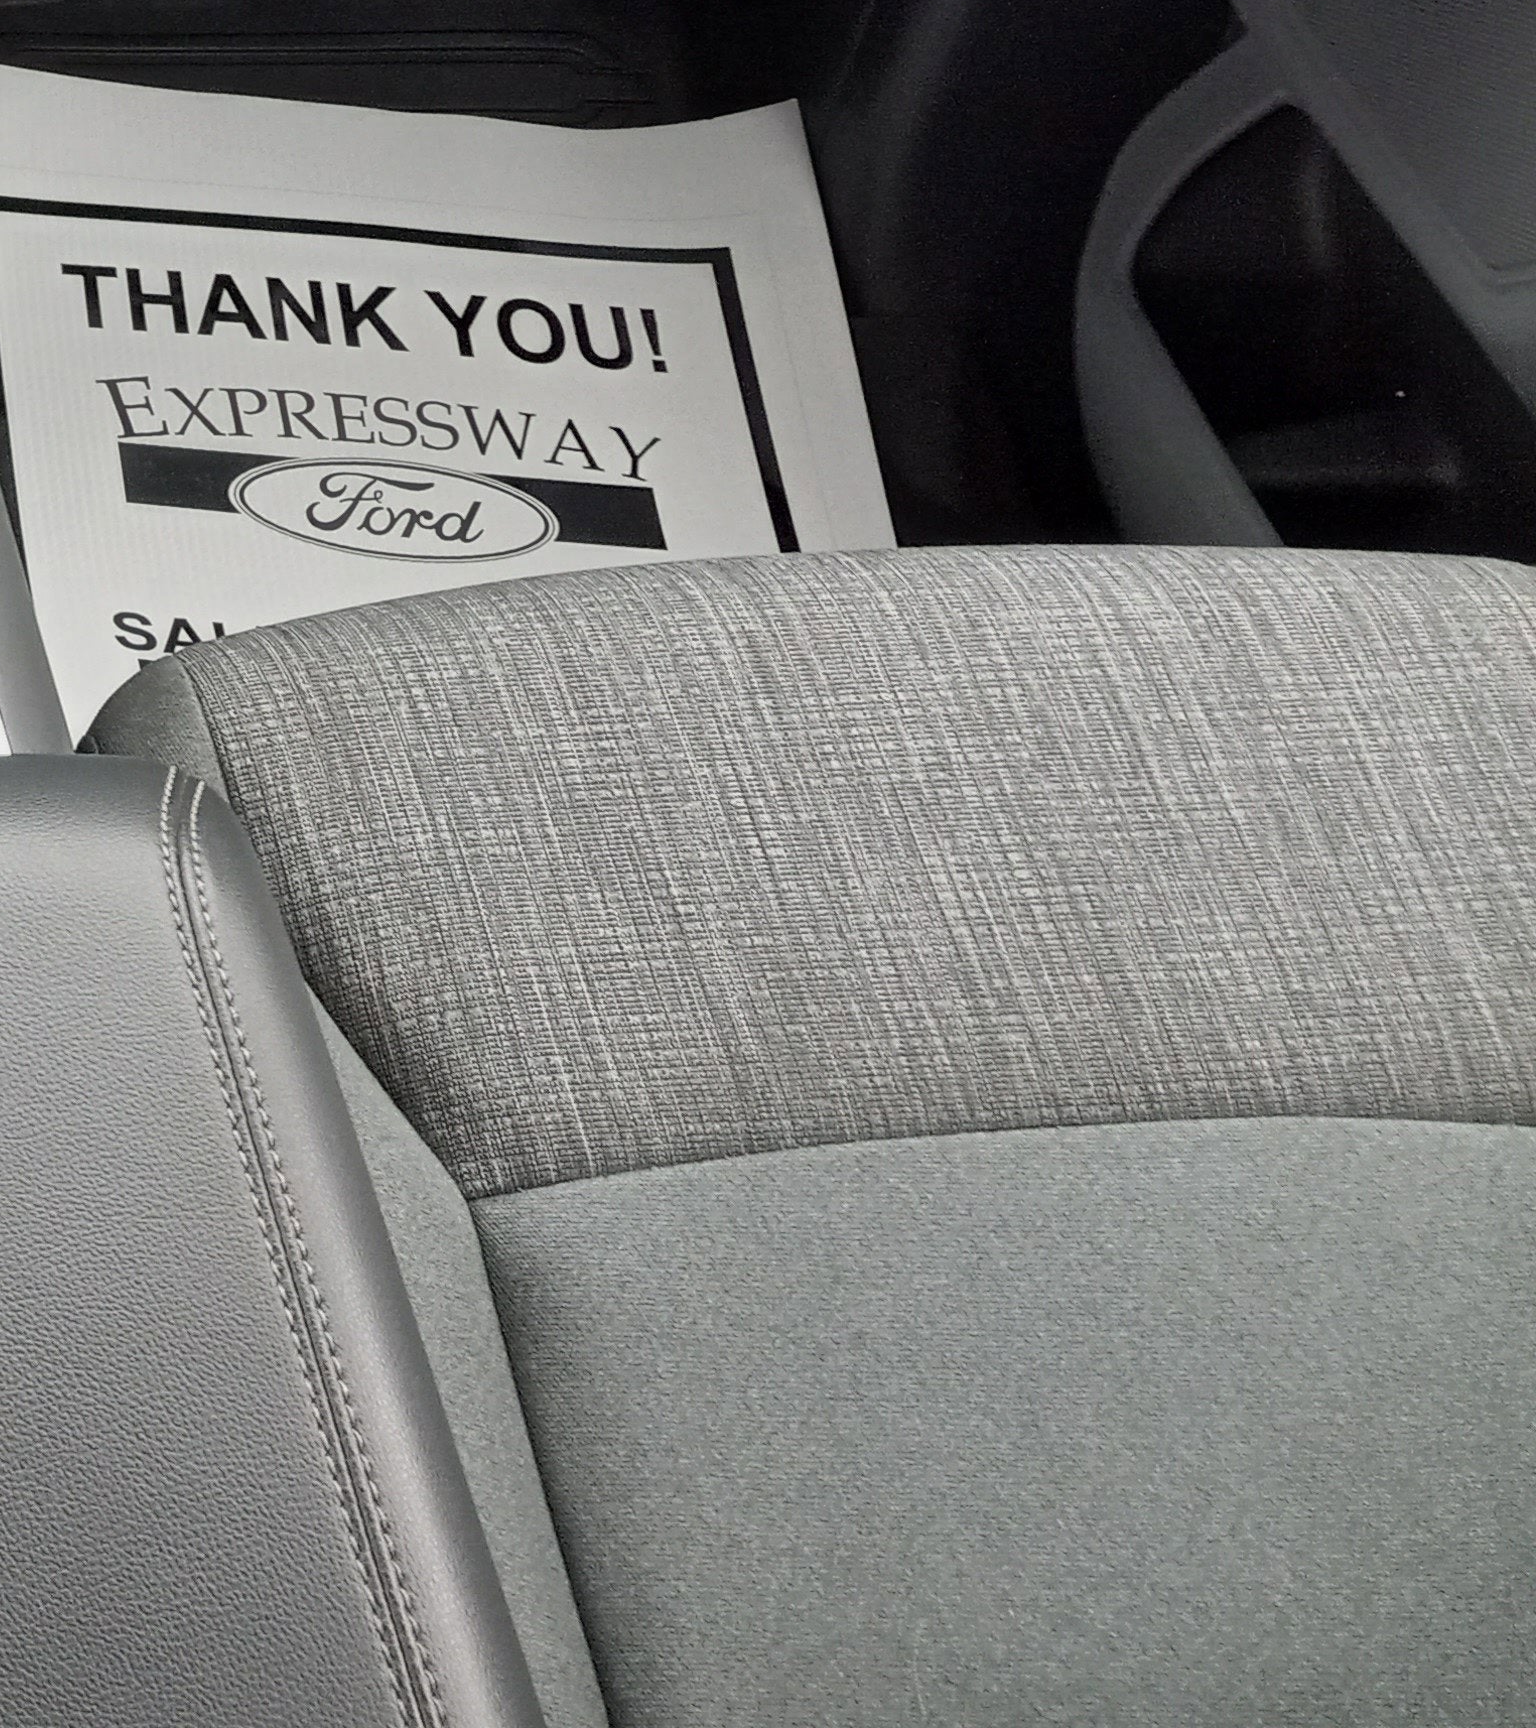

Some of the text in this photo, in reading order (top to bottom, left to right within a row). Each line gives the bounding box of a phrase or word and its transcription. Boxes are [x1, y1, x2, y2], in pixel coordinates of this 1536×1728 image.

[60, 263, 670, 375] THANK YOU!
[95, 375, 664, 482] EXPRESSWAY
[305, 471, 486, 546] Ford
